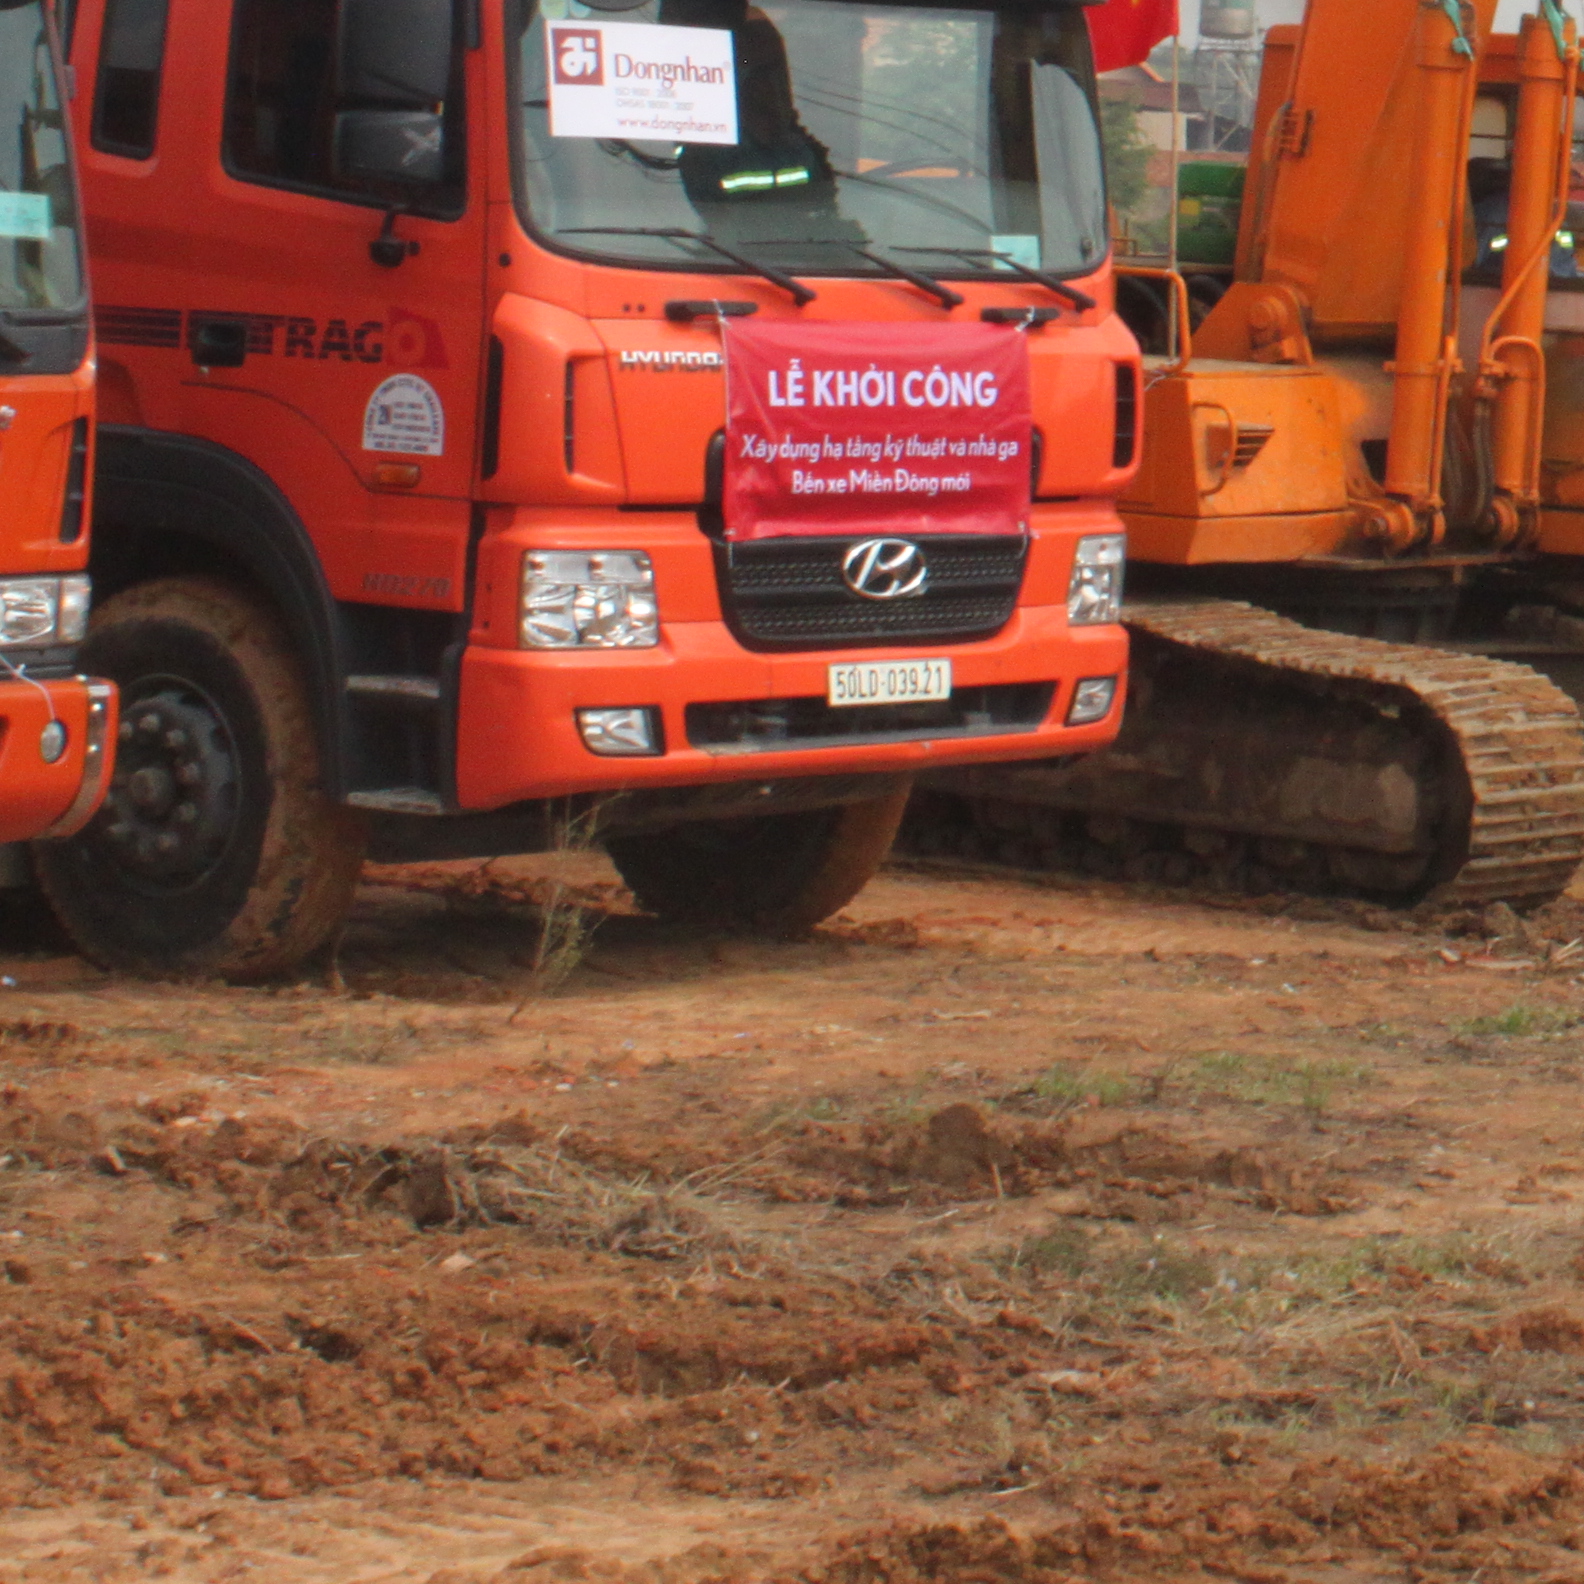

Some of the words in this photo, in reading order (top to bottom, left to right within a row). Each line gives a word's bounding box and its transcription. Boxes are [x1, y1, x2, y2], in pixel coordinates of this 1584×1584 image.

[768, 358, 804, 407] LỄ
[813, 363, 896, 407] KHỞI
[903, 364, 998, 407] CÔNG
[740, 434, 778, 463] Xây
[823, 434, 843, 461] hạ
[846, 435, 882, 463] tầng
[885, 434, 905, 464] kỹ
[906, 434, 948, 460] thuật
[949, 438, 967, 457] và
[968, 433, 997, 458] nhà
[998, 440, 1019, 462] ga
[791, 471, 825, 494] Bến
[827, 476, 848, 492] xe
[849, 469, 893, 493] Miền
[894, 469, 939, 496] Đông
